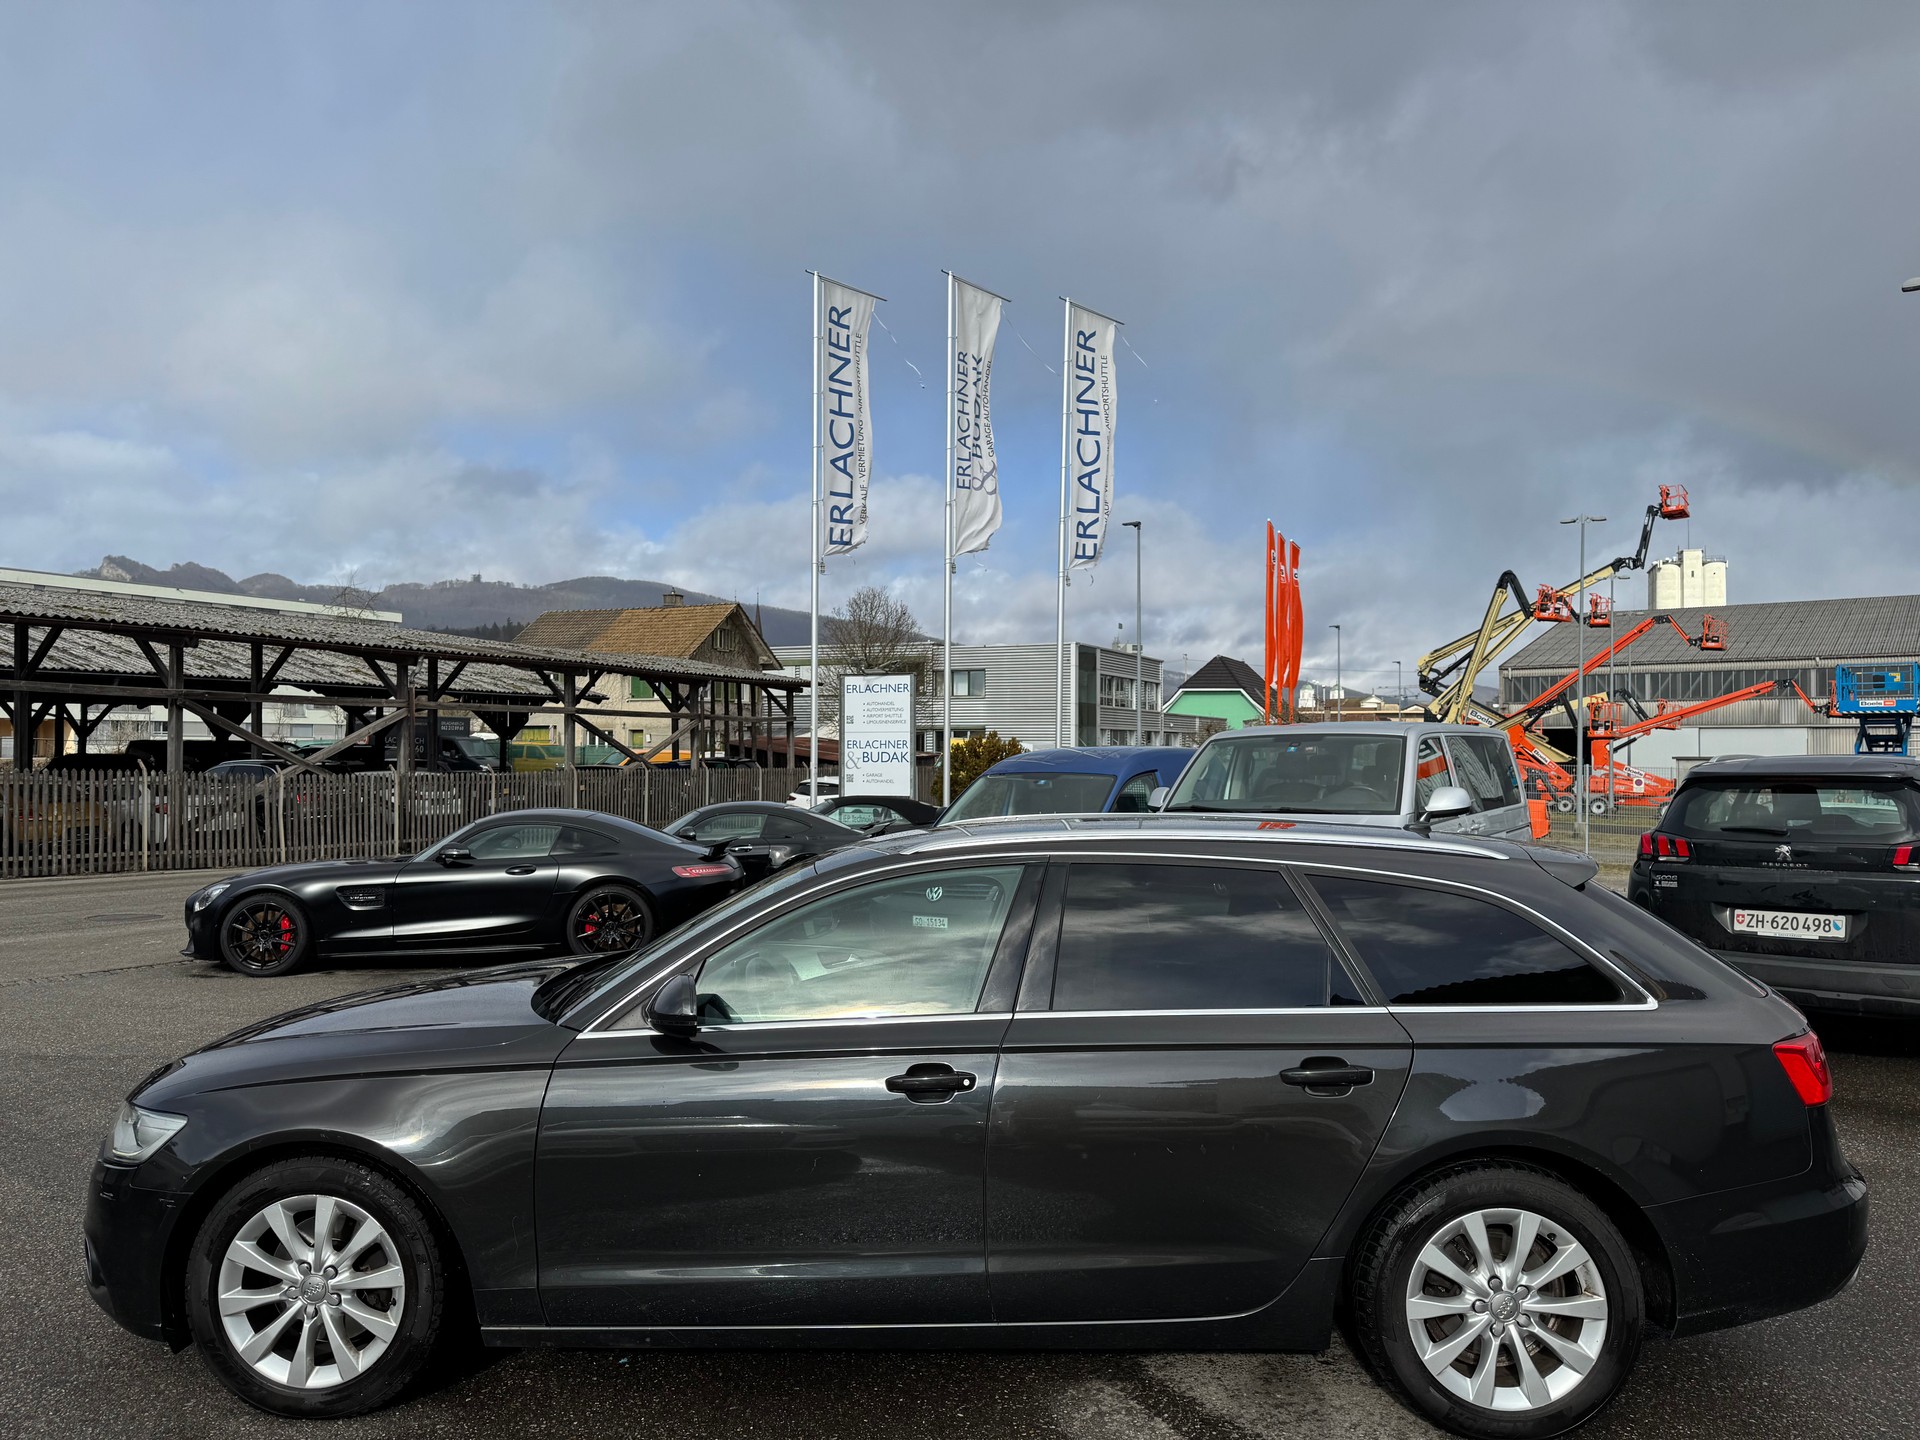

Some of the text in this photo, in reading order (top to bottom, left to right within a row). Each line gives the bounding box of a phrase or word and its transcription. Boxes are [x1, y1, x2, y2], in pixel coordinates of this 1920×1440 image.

[828, 306, 854, 545] ERLACHNER
[957, 351, 971, 490] ERLACHNER
[858, 420, 866, 479] VERMIETUNG
[984, 422, 994, 457] GARAGE
[1075, 330, 1100, 560] ERLACHNER
[972, 460, 997, 496] &
[846, 683, 910, 694] ERLACHNER
[1470, 709, 1494, 726] Boels
[845, 751, 909, 770] & BUDAK
[846, 740, 908, 749] ERLACHNER
